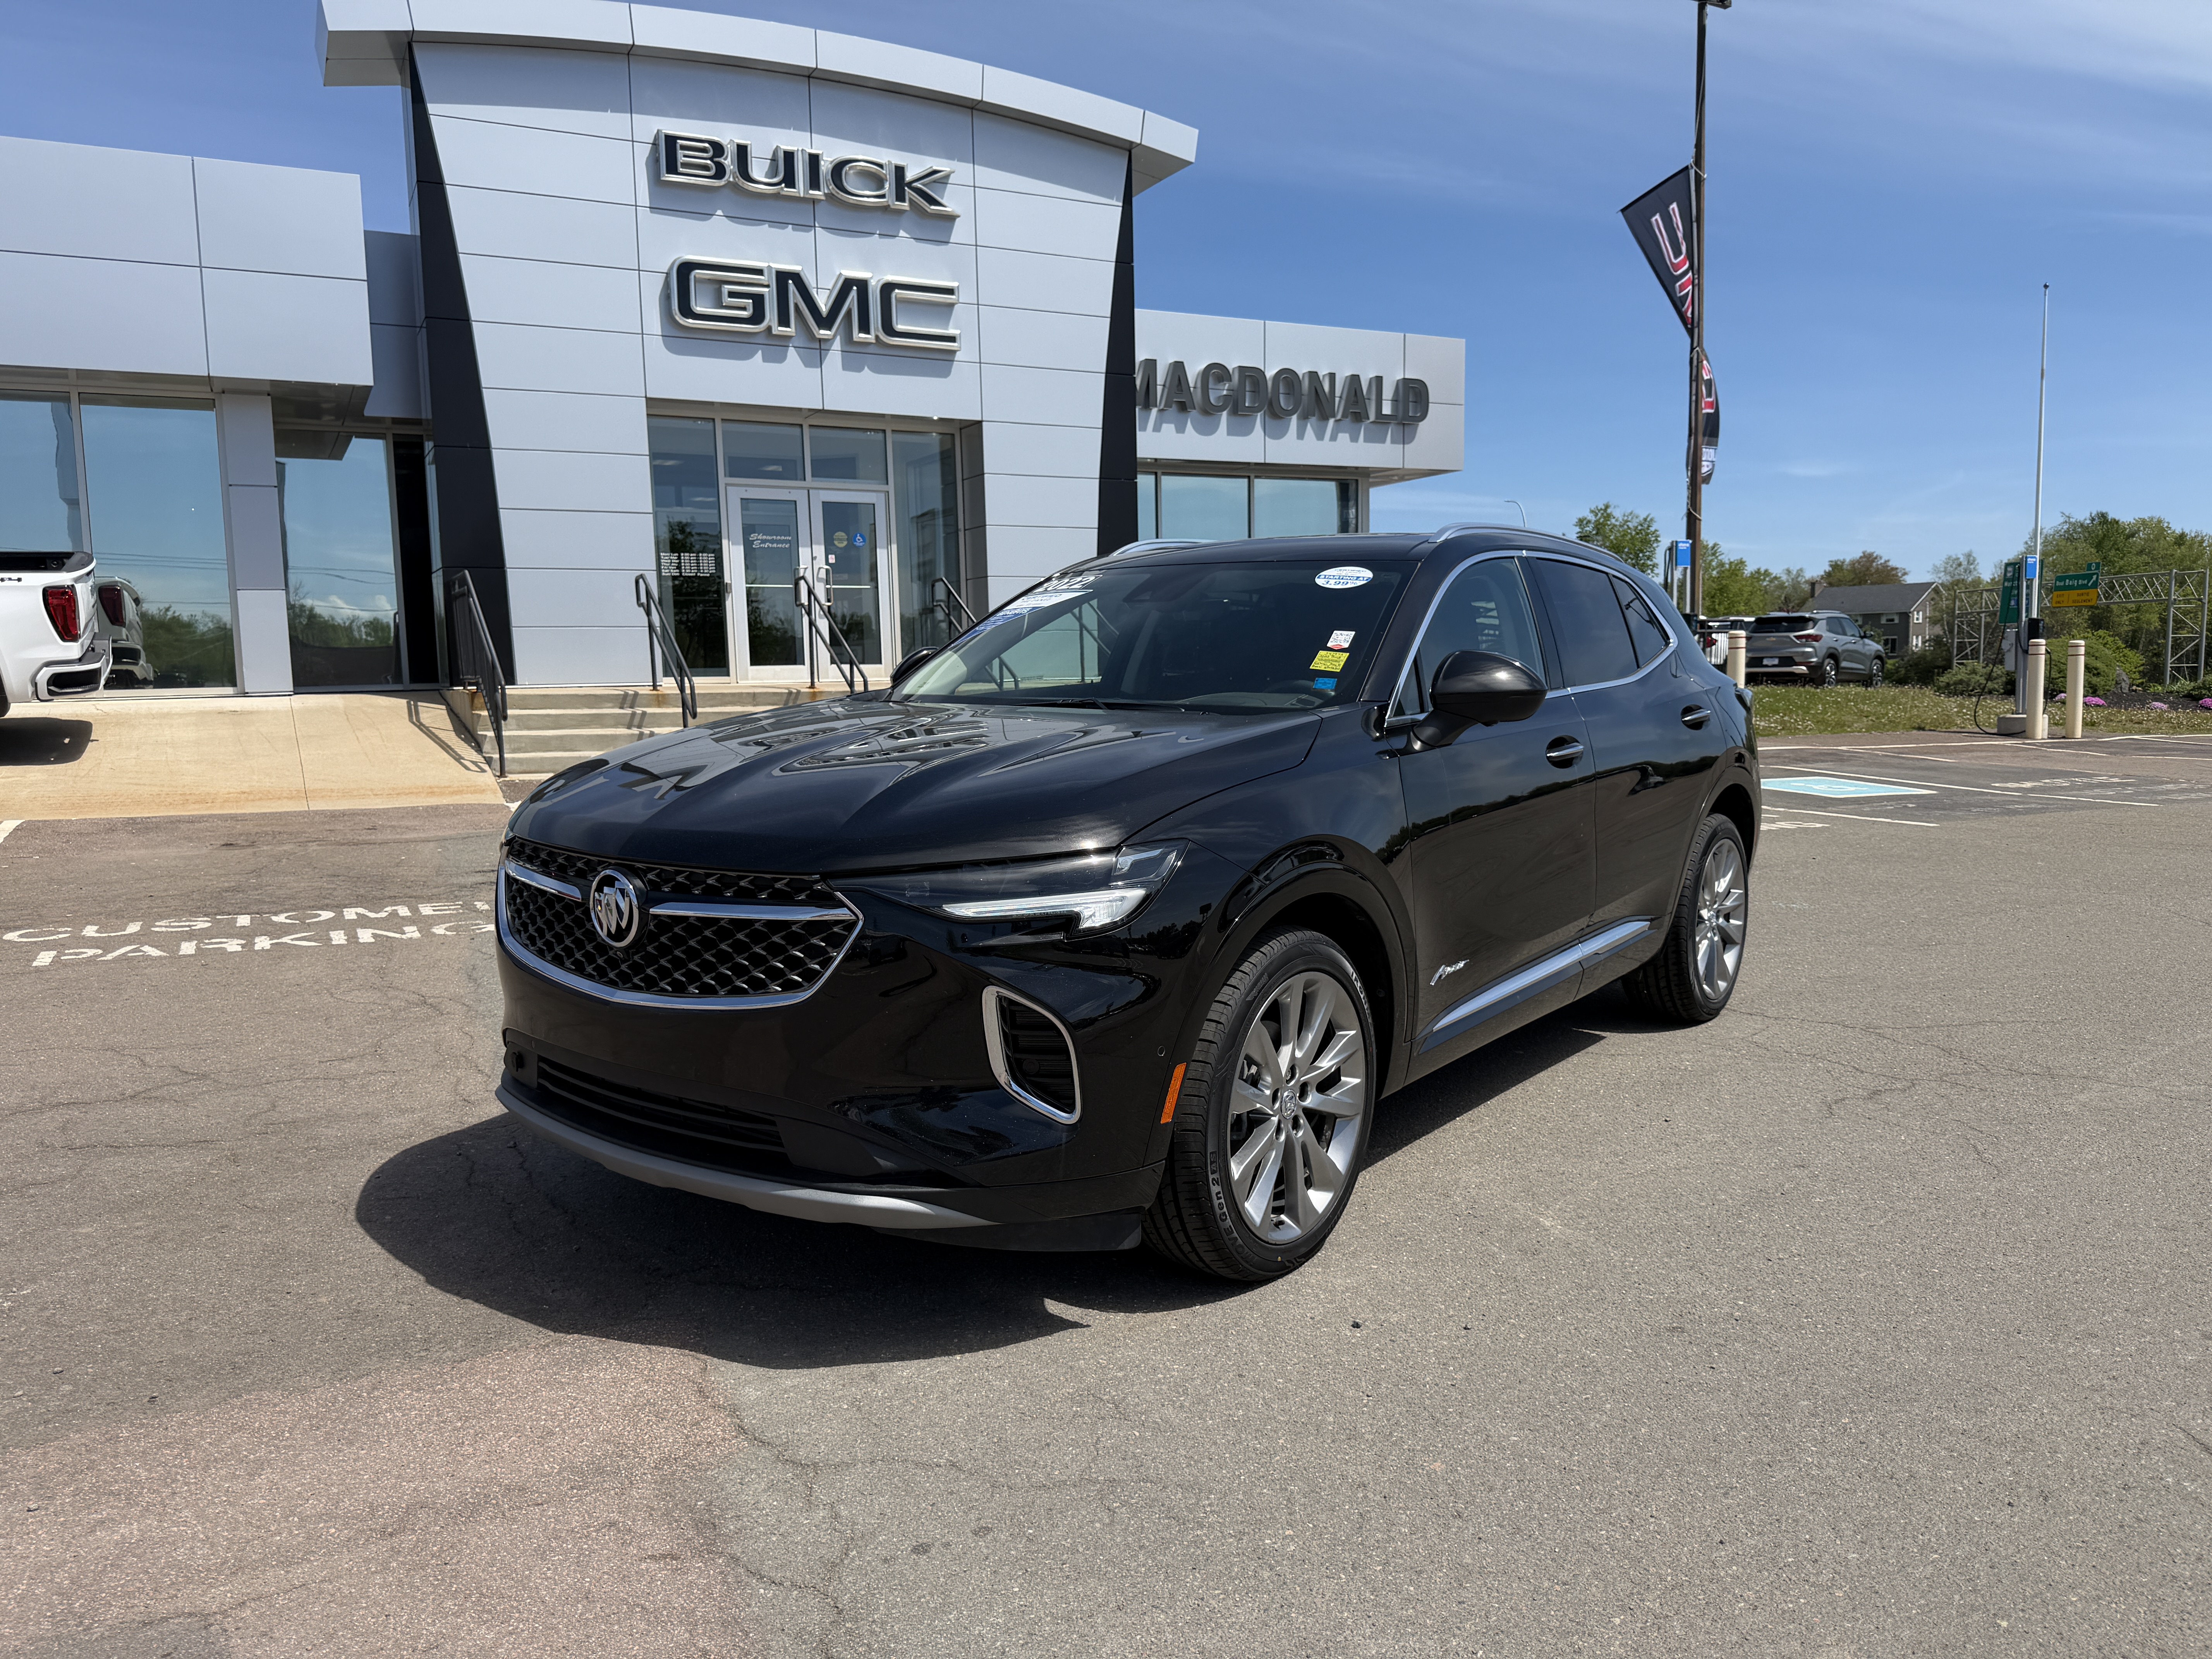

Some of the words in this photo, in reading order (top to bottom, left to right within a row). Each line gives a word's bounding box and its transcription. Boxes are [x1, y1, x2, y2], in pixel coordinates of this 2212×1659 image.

[656, 129, 961, 218] BUICK
[668, 255, 961, 351] GMC
[1033, 577, 1096, 593] 2022
[32, 921, 495, 967] PARKING
[1211, 1177, 1220, 1187] 2
[1215, 1190, 1227, 1223] Gen
